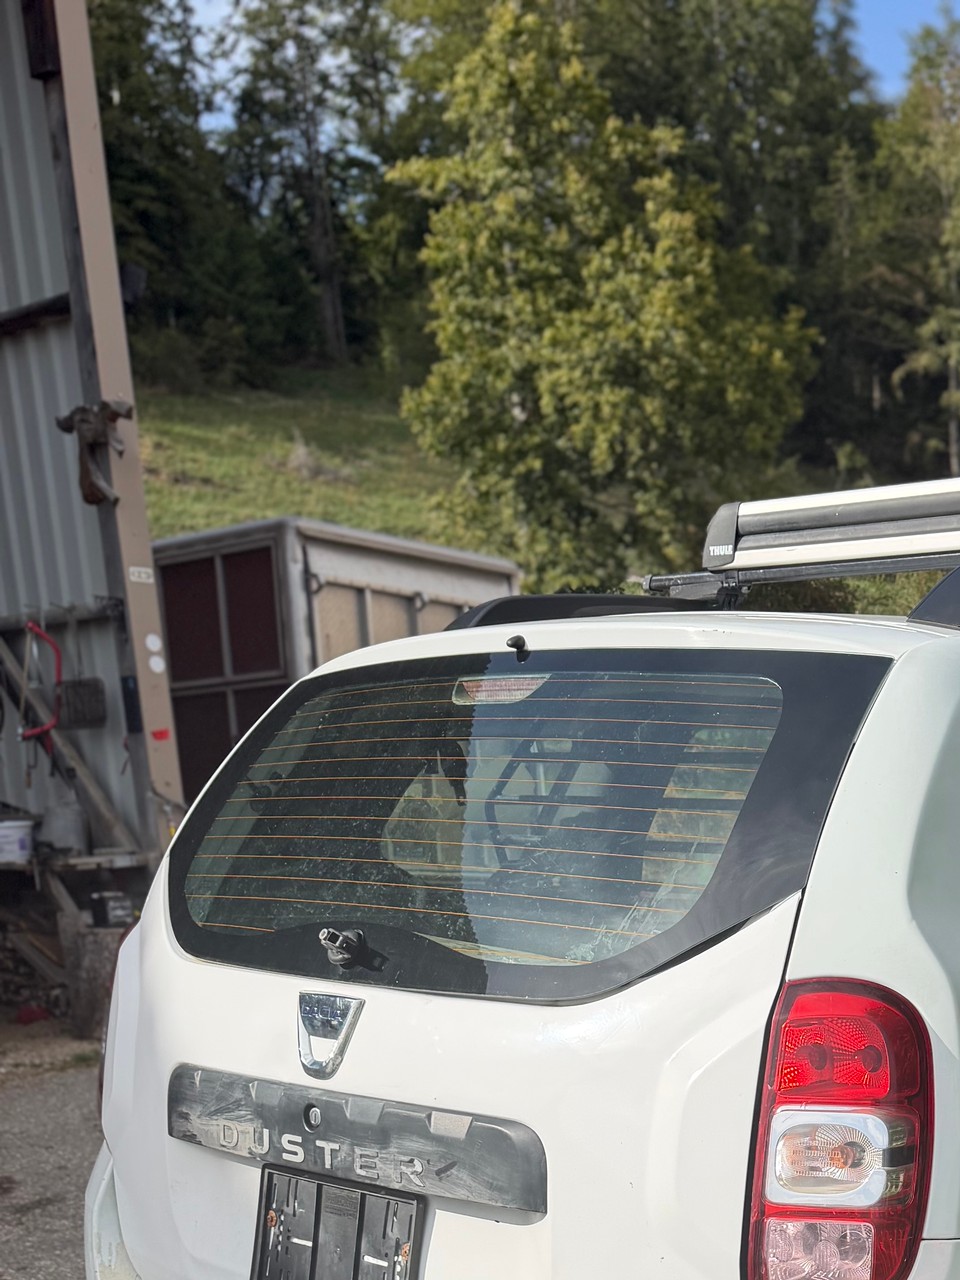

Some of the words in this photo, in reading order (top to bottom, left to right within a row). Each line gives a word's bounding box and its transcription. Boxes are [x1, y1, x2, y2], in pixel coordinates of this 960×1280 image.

[709, 544, 733, 556] THULE
[301, 1003, 346, 1022] DACIA
[219, 1122, 426, 1187] DUSTER
